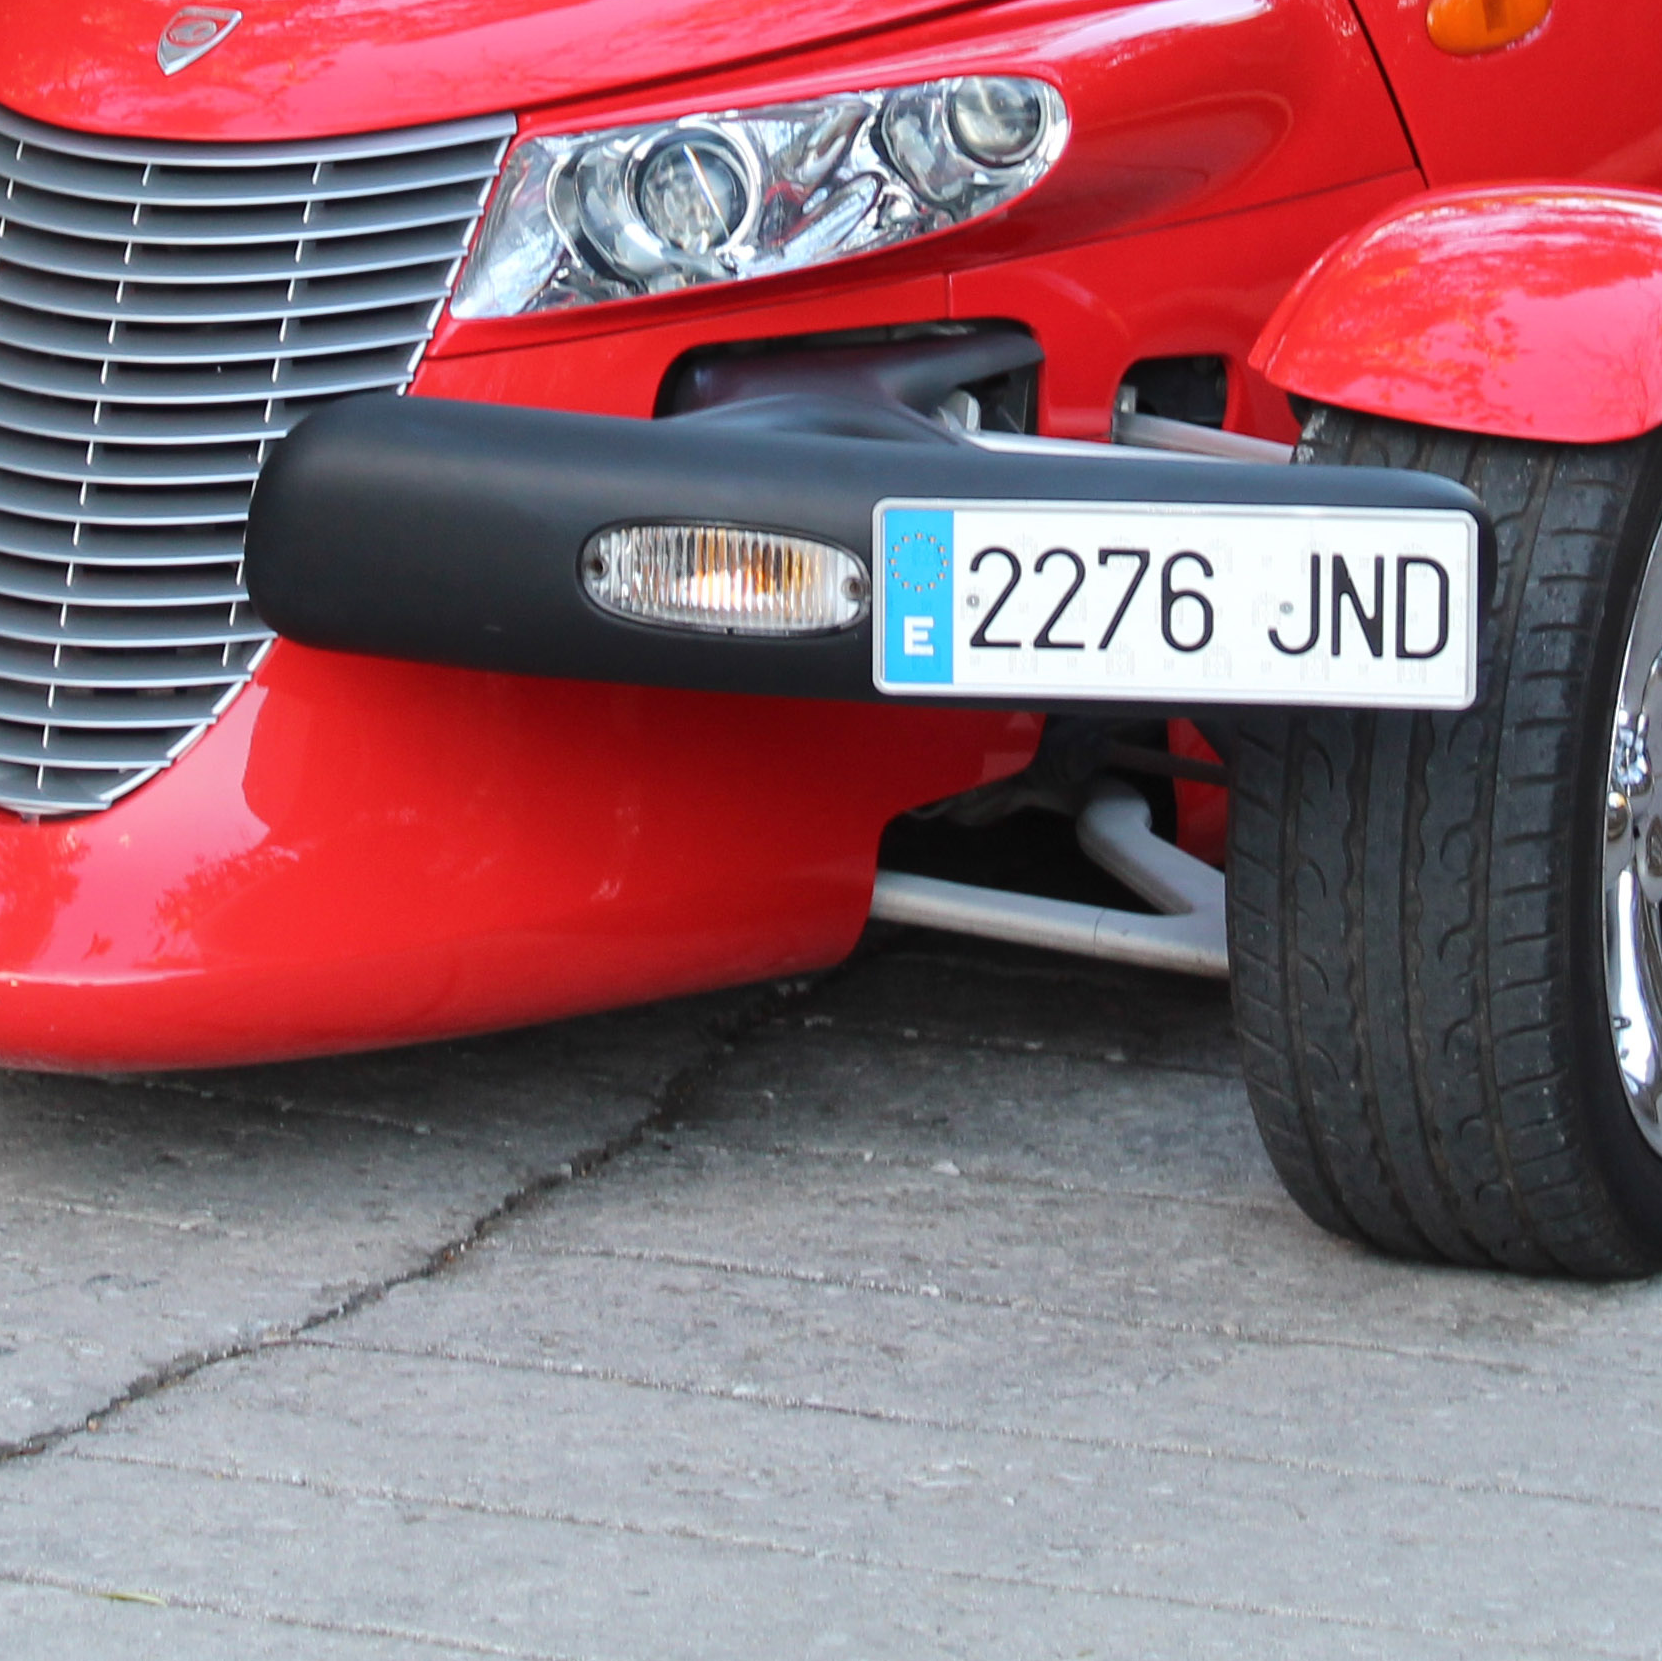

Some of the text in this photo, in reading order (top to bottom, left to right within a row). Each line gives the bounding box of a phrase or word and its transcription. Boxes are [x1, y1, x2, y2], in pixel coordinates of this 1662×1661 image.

[903, 615, 935, 657] E
[969, 547, 1450, 660] 2276 JND
